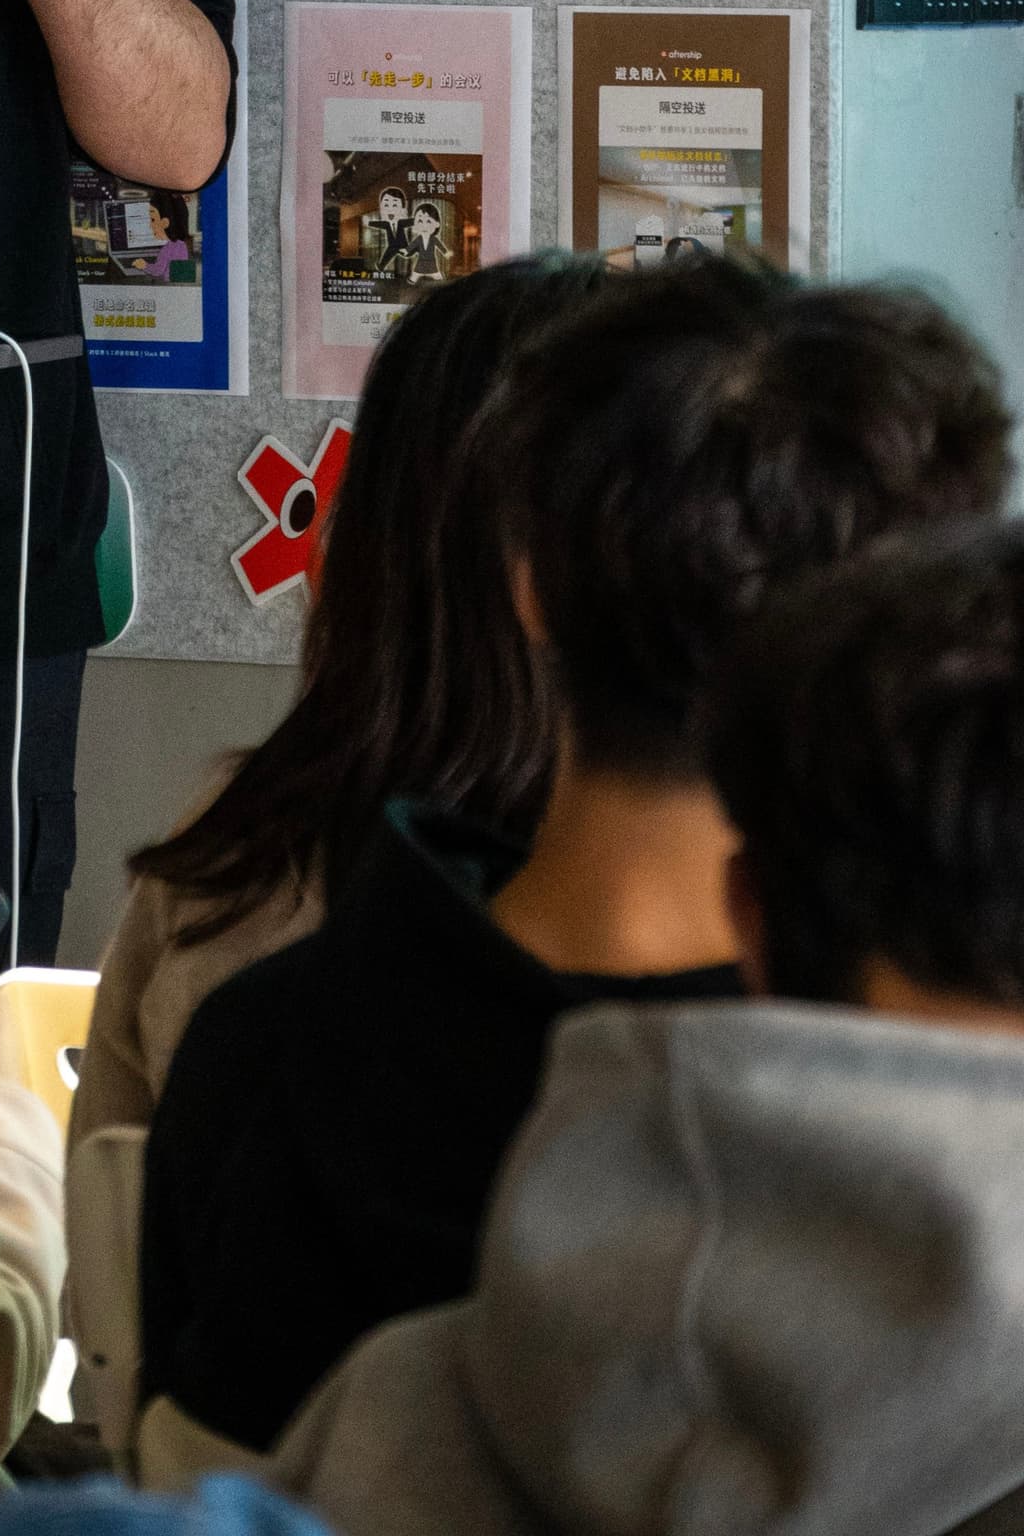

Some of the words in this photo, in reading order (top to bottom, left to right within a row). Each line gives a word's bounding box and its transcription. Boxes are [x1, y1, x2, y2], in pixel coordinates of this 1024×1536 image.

[327, 69, 482, 90] 可以「先走一步」的会议
[658, 101, 706, 115] 隔空投送
[380, 110, 426, 125] 隔空投送
